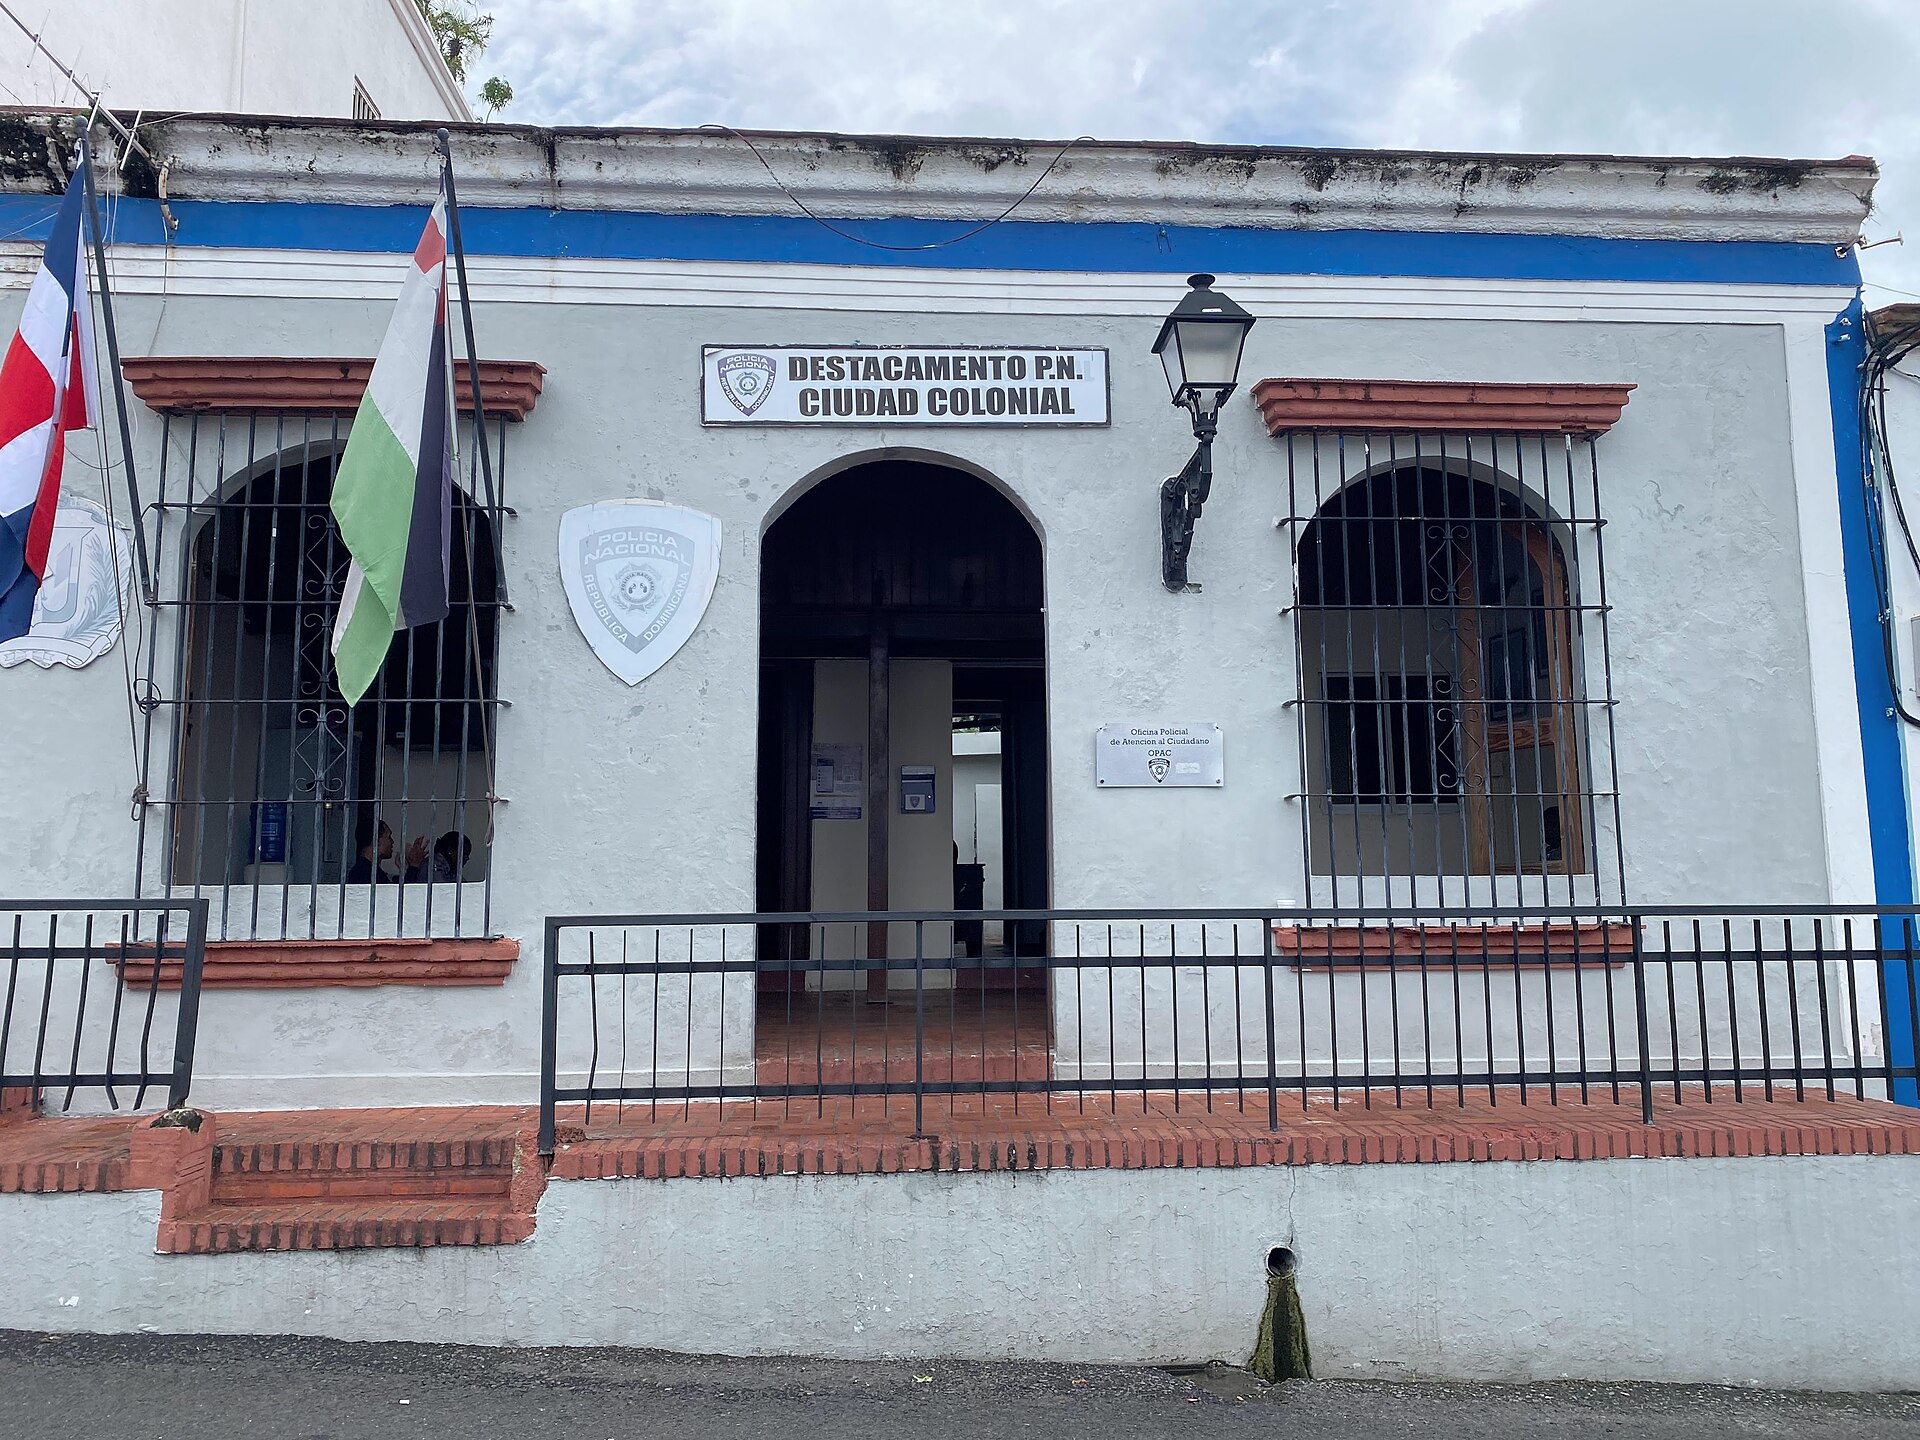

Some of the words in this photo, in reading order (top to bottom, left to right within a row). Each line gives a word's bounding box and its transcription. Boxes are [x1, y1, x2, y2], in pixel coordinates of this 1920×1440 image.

[720, 361, 775, 373] NACIONAL
[726, 355, 768, 364] POLICIA
[788, 355, 1026, 381] DESTACAMENTO
[1034, 355, 1083, 380] P.N.
[720, 377, 745, 411] REPUBLICA
[751, 375, 774, 410] DOMINICANA
[799, 387, 920, 417] CIUDAD
[927, 386, 1075, 416] COLONIAL
[598, 531, 678, 548] POLICIA
[584, 543, 691, 567] NACIONAL
[584, 574, 628, 643] REPUBLICA
[643, 572, 690, 642] DOMINICANA
[1130, 728, 1158, 736] Oficina
[1160, 728, 1189, 736] Policial
[1110, 738, 1120, 746] de
[1122, 738, 1157, 746] Atencion
[1166, 737, 1210, 745] Ciudadano
[1147, 749, 1172, 757] OPAC
